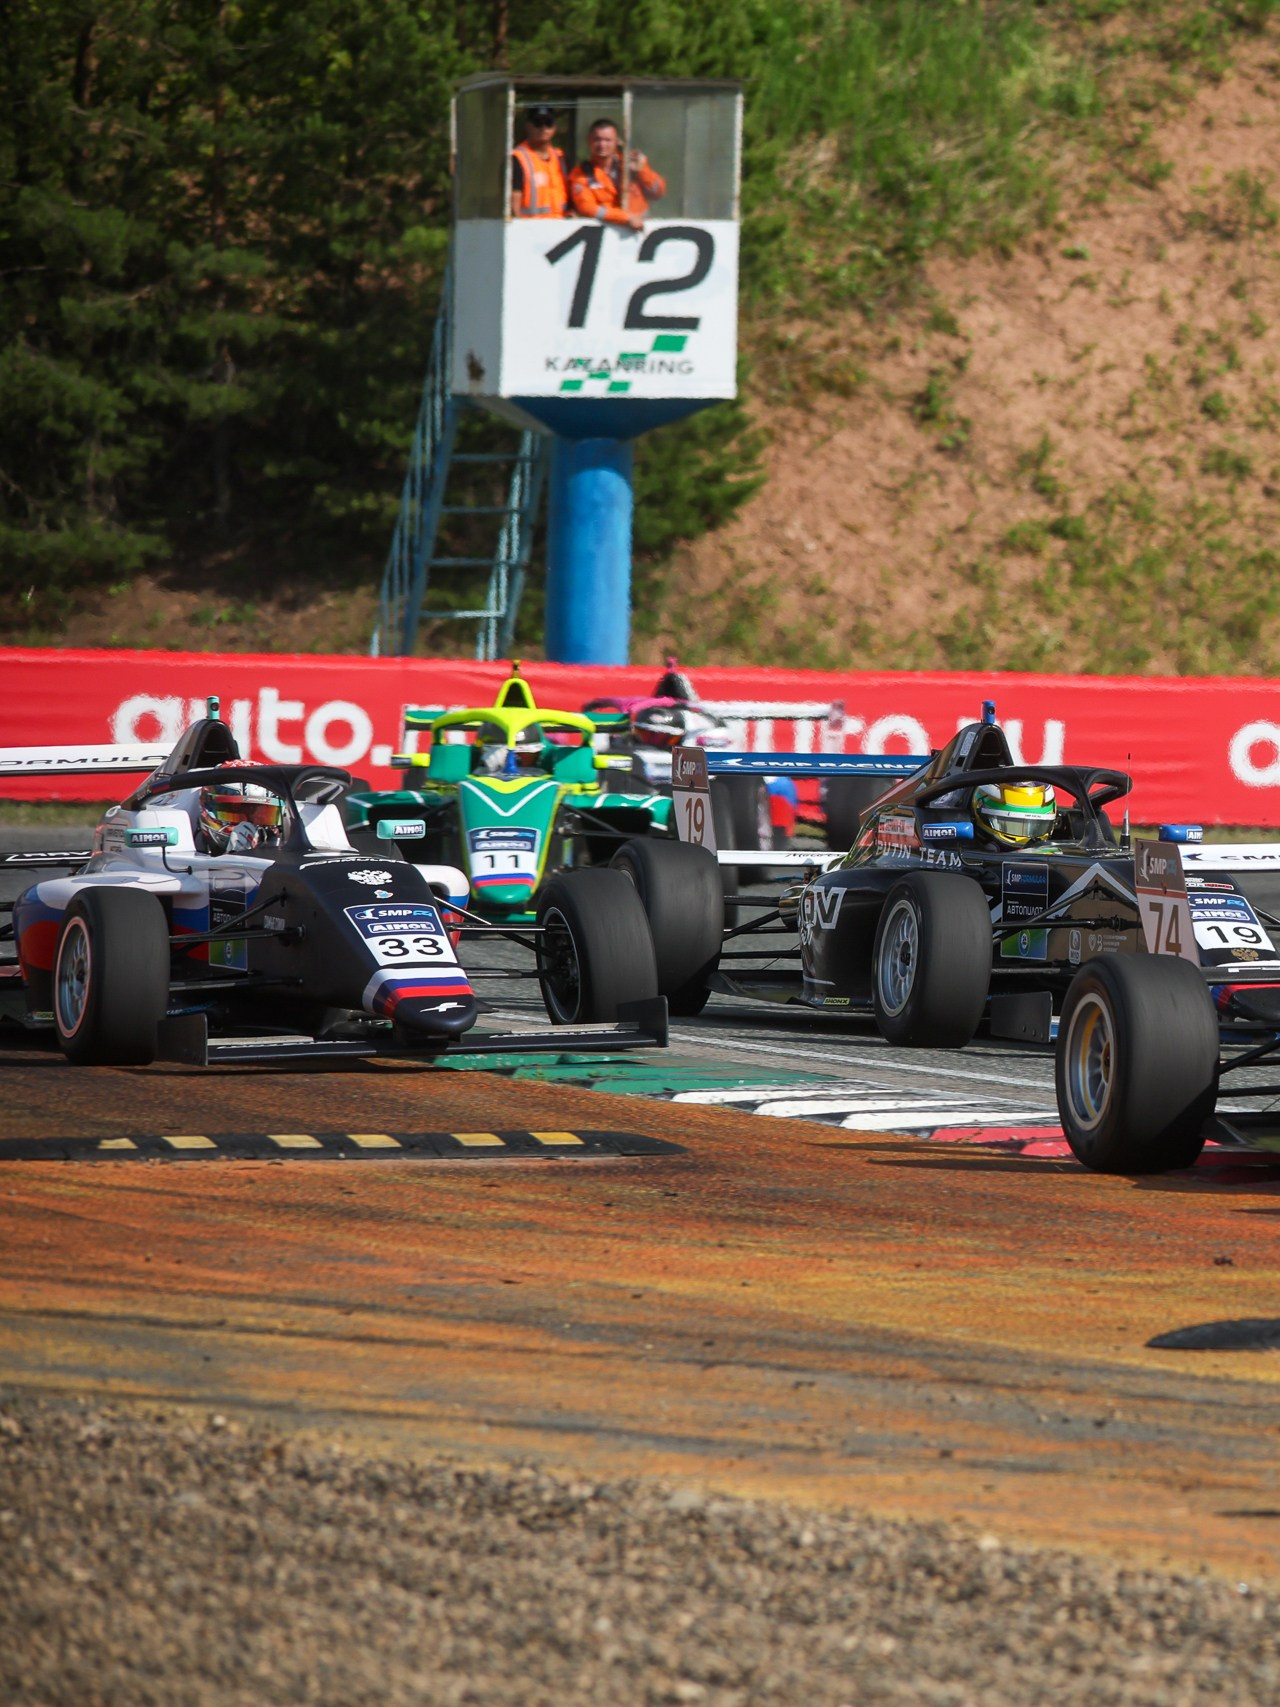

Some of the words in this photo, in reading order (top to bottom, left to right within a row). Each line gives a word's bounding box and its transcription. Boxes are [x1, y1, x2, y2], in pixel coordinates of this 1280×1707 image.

[545, 225, 715, 330] 12
[685, 797, 705, 844] 19
[131, 833, 168, 844] AIMOL
[924, 827, 956, 837] AIMOL
[483, 854, 520, 869] 11
[876, 840, 912, 860] PUTIN
[919, 847, 962, 868] TEAM
[1149, 857, 1168, 875] SMP
[1194, 897, 1226, 905] SMP
[378, 909, 413, 918] SMP
[1192, 910, 1247, 920] AIMOL
[372, 923, 433, 933] AIMOL
[1149, 901, 1182, 955] 74
[1207, 925, 1262, 944] 19
[378, 937, 444, 957] 33
